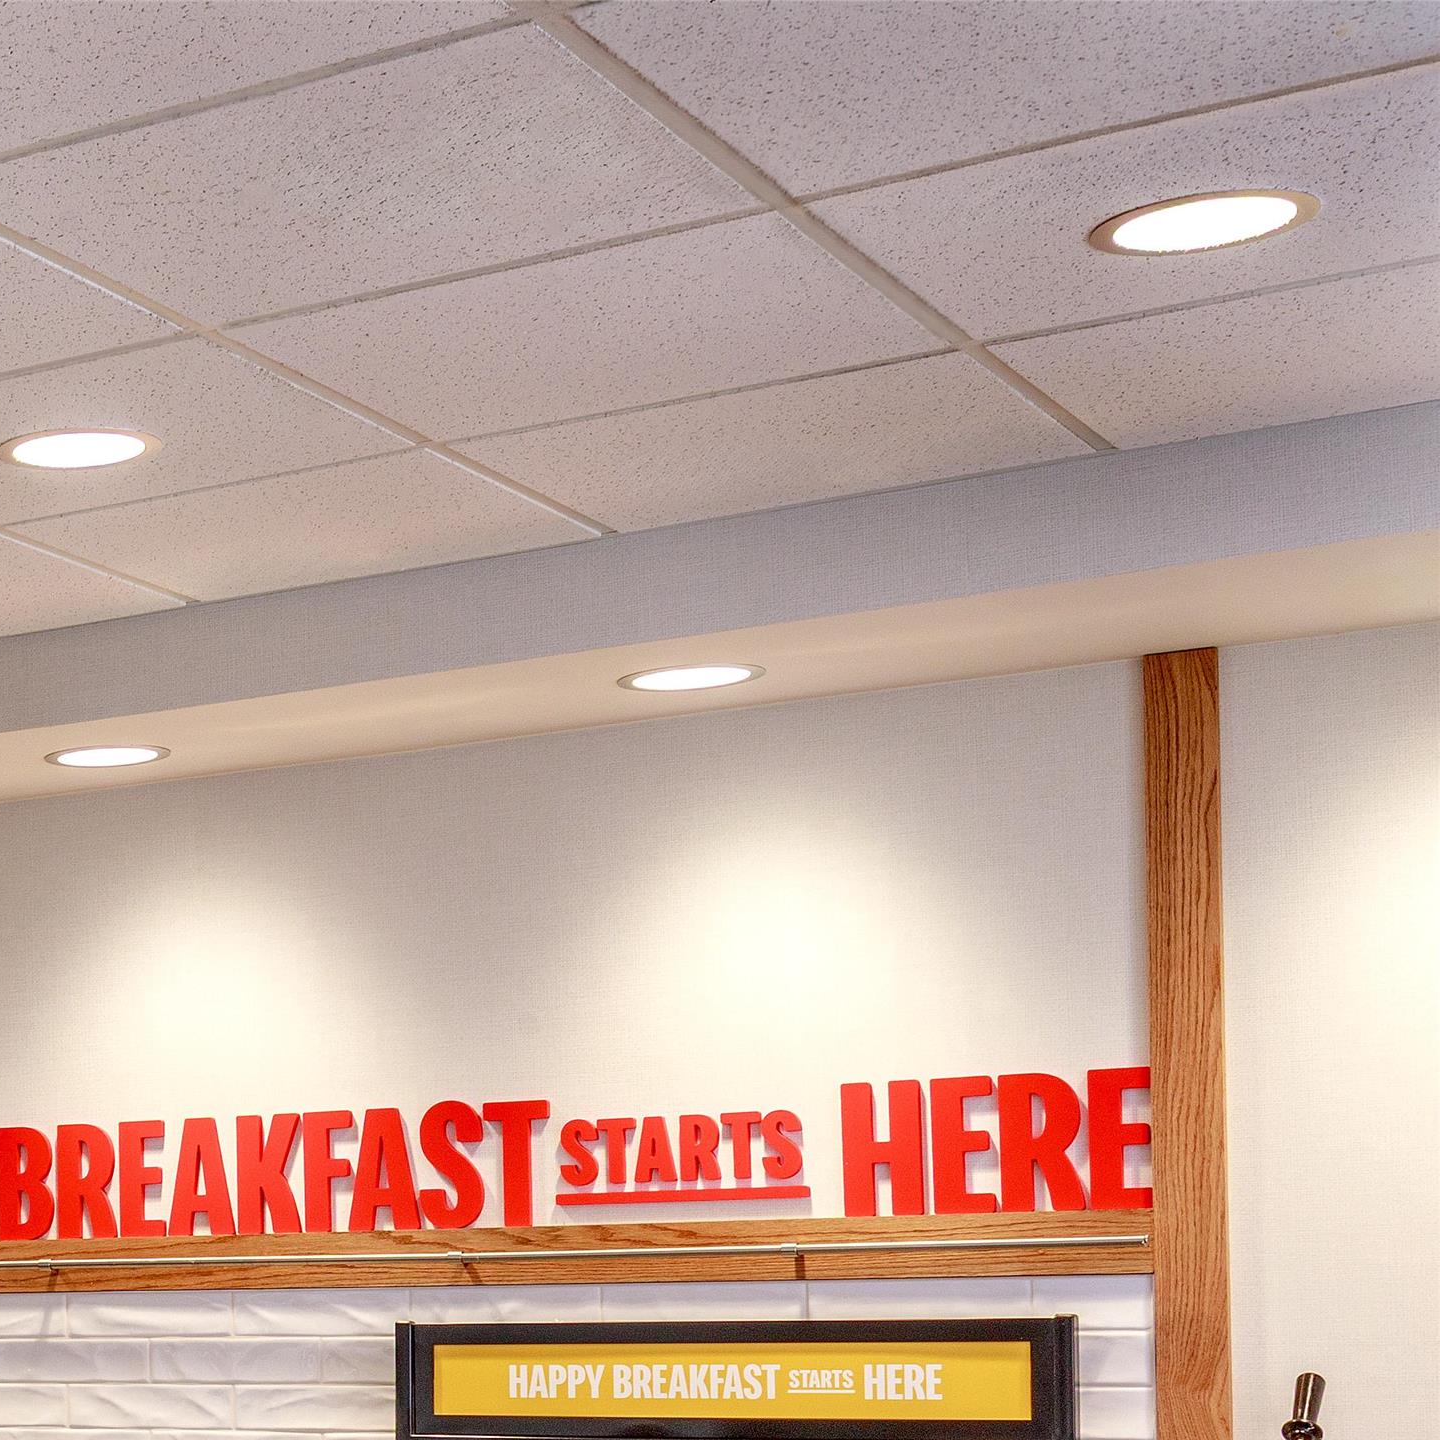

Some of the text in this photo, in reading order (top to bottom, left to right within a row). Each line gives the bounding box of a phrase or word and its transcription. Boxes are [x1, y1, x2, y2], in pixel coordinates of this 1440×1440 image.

[560, 1110, 804, 1188] STARTS
[840, 1066, 1155, 1218] HERE
[509, 1363, 943, 1401] HAPPY BREAKFAST STARTS HERE
